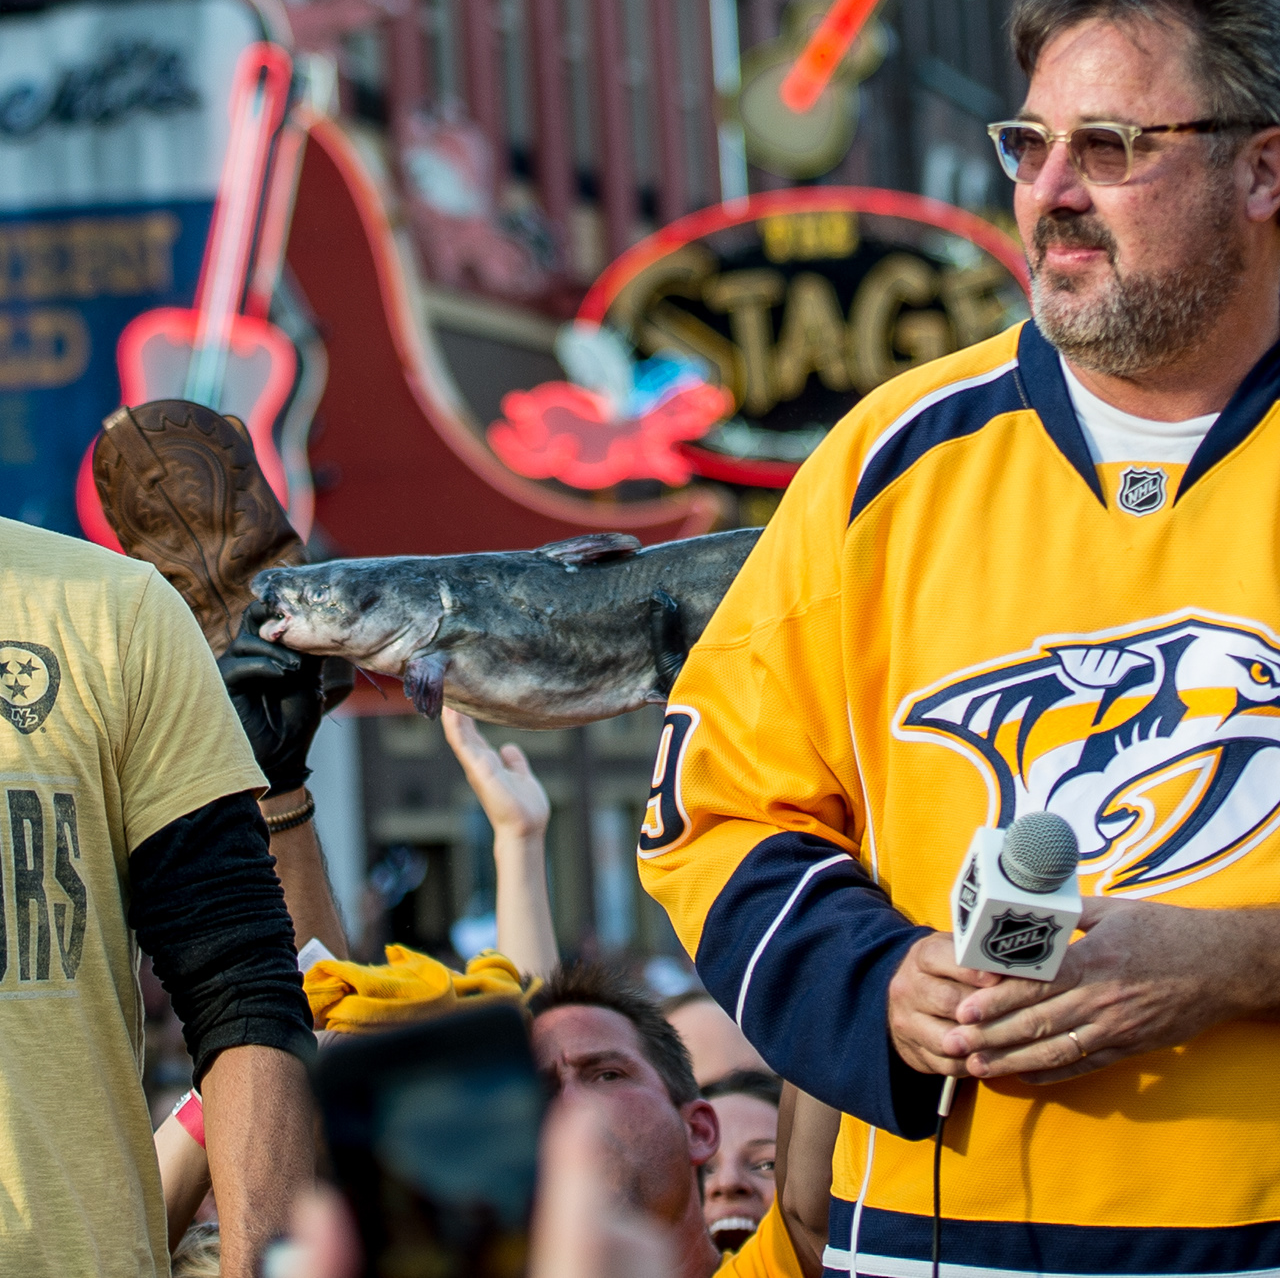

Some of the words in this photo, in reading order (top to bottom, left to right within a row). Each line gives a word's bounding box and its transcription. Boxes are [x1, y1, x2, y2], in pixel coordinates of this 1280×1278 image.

[1127, 479, 1158, 506] NHL
[960, 887, 977, 908] NHL
[996, 928, 1044, 954] NHL
